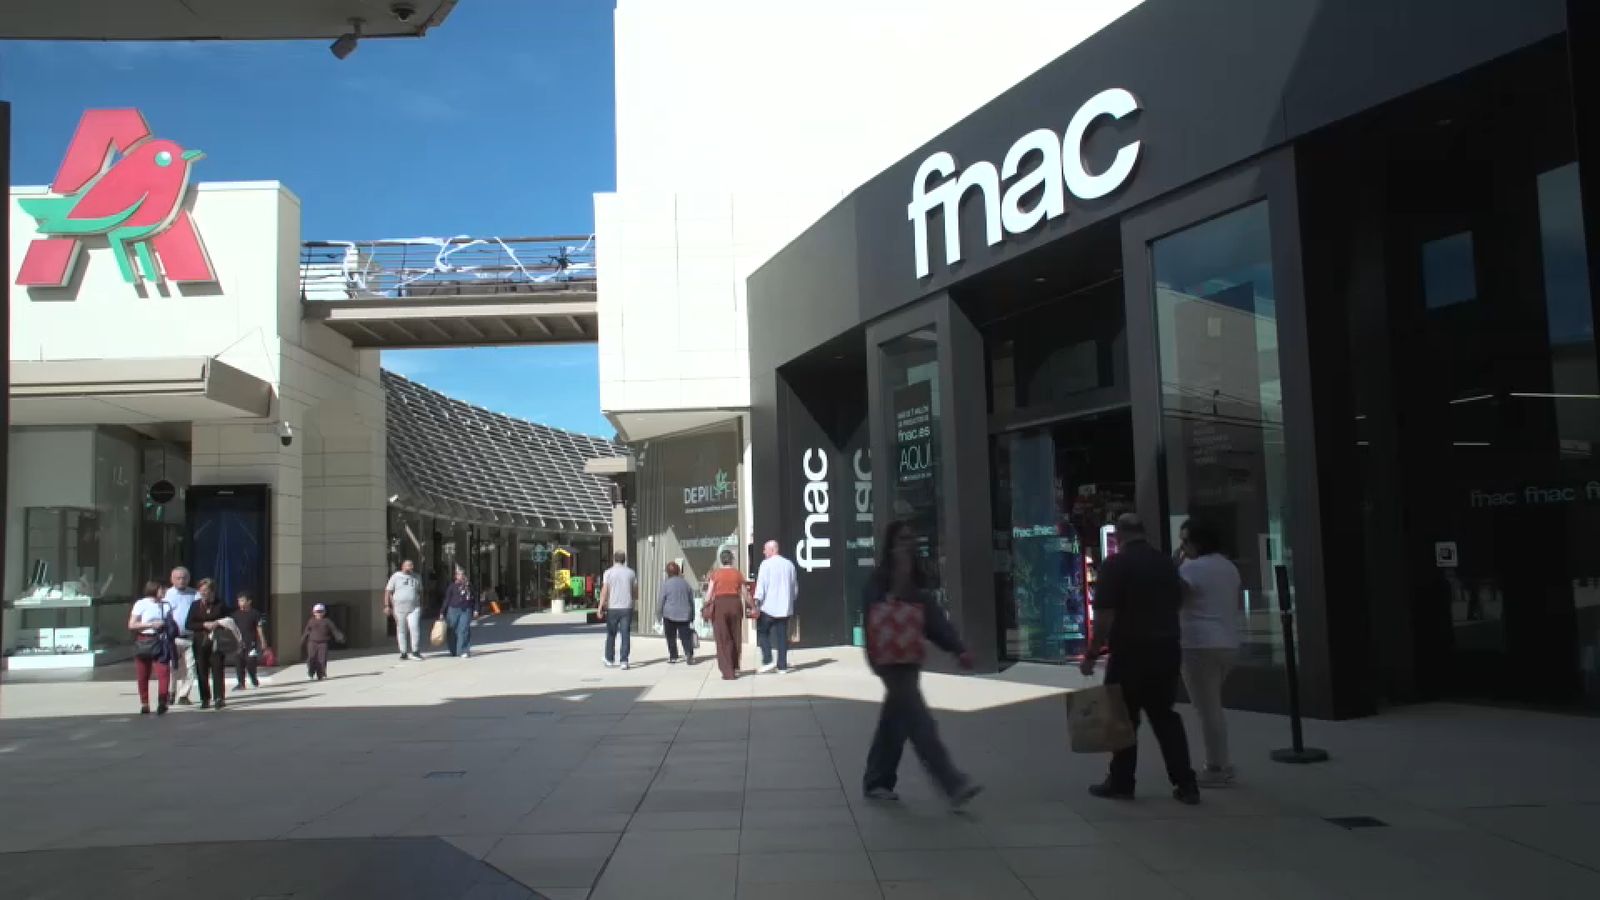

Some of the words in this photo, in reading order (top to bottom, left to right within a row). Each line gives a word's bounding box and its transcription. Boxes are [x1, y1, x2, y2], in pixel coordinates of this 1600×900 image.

[907, 87, 1141, 280] fnac
[796, 447, 831, 573] fnac
[1525, 486, 1576, 505] fnac
